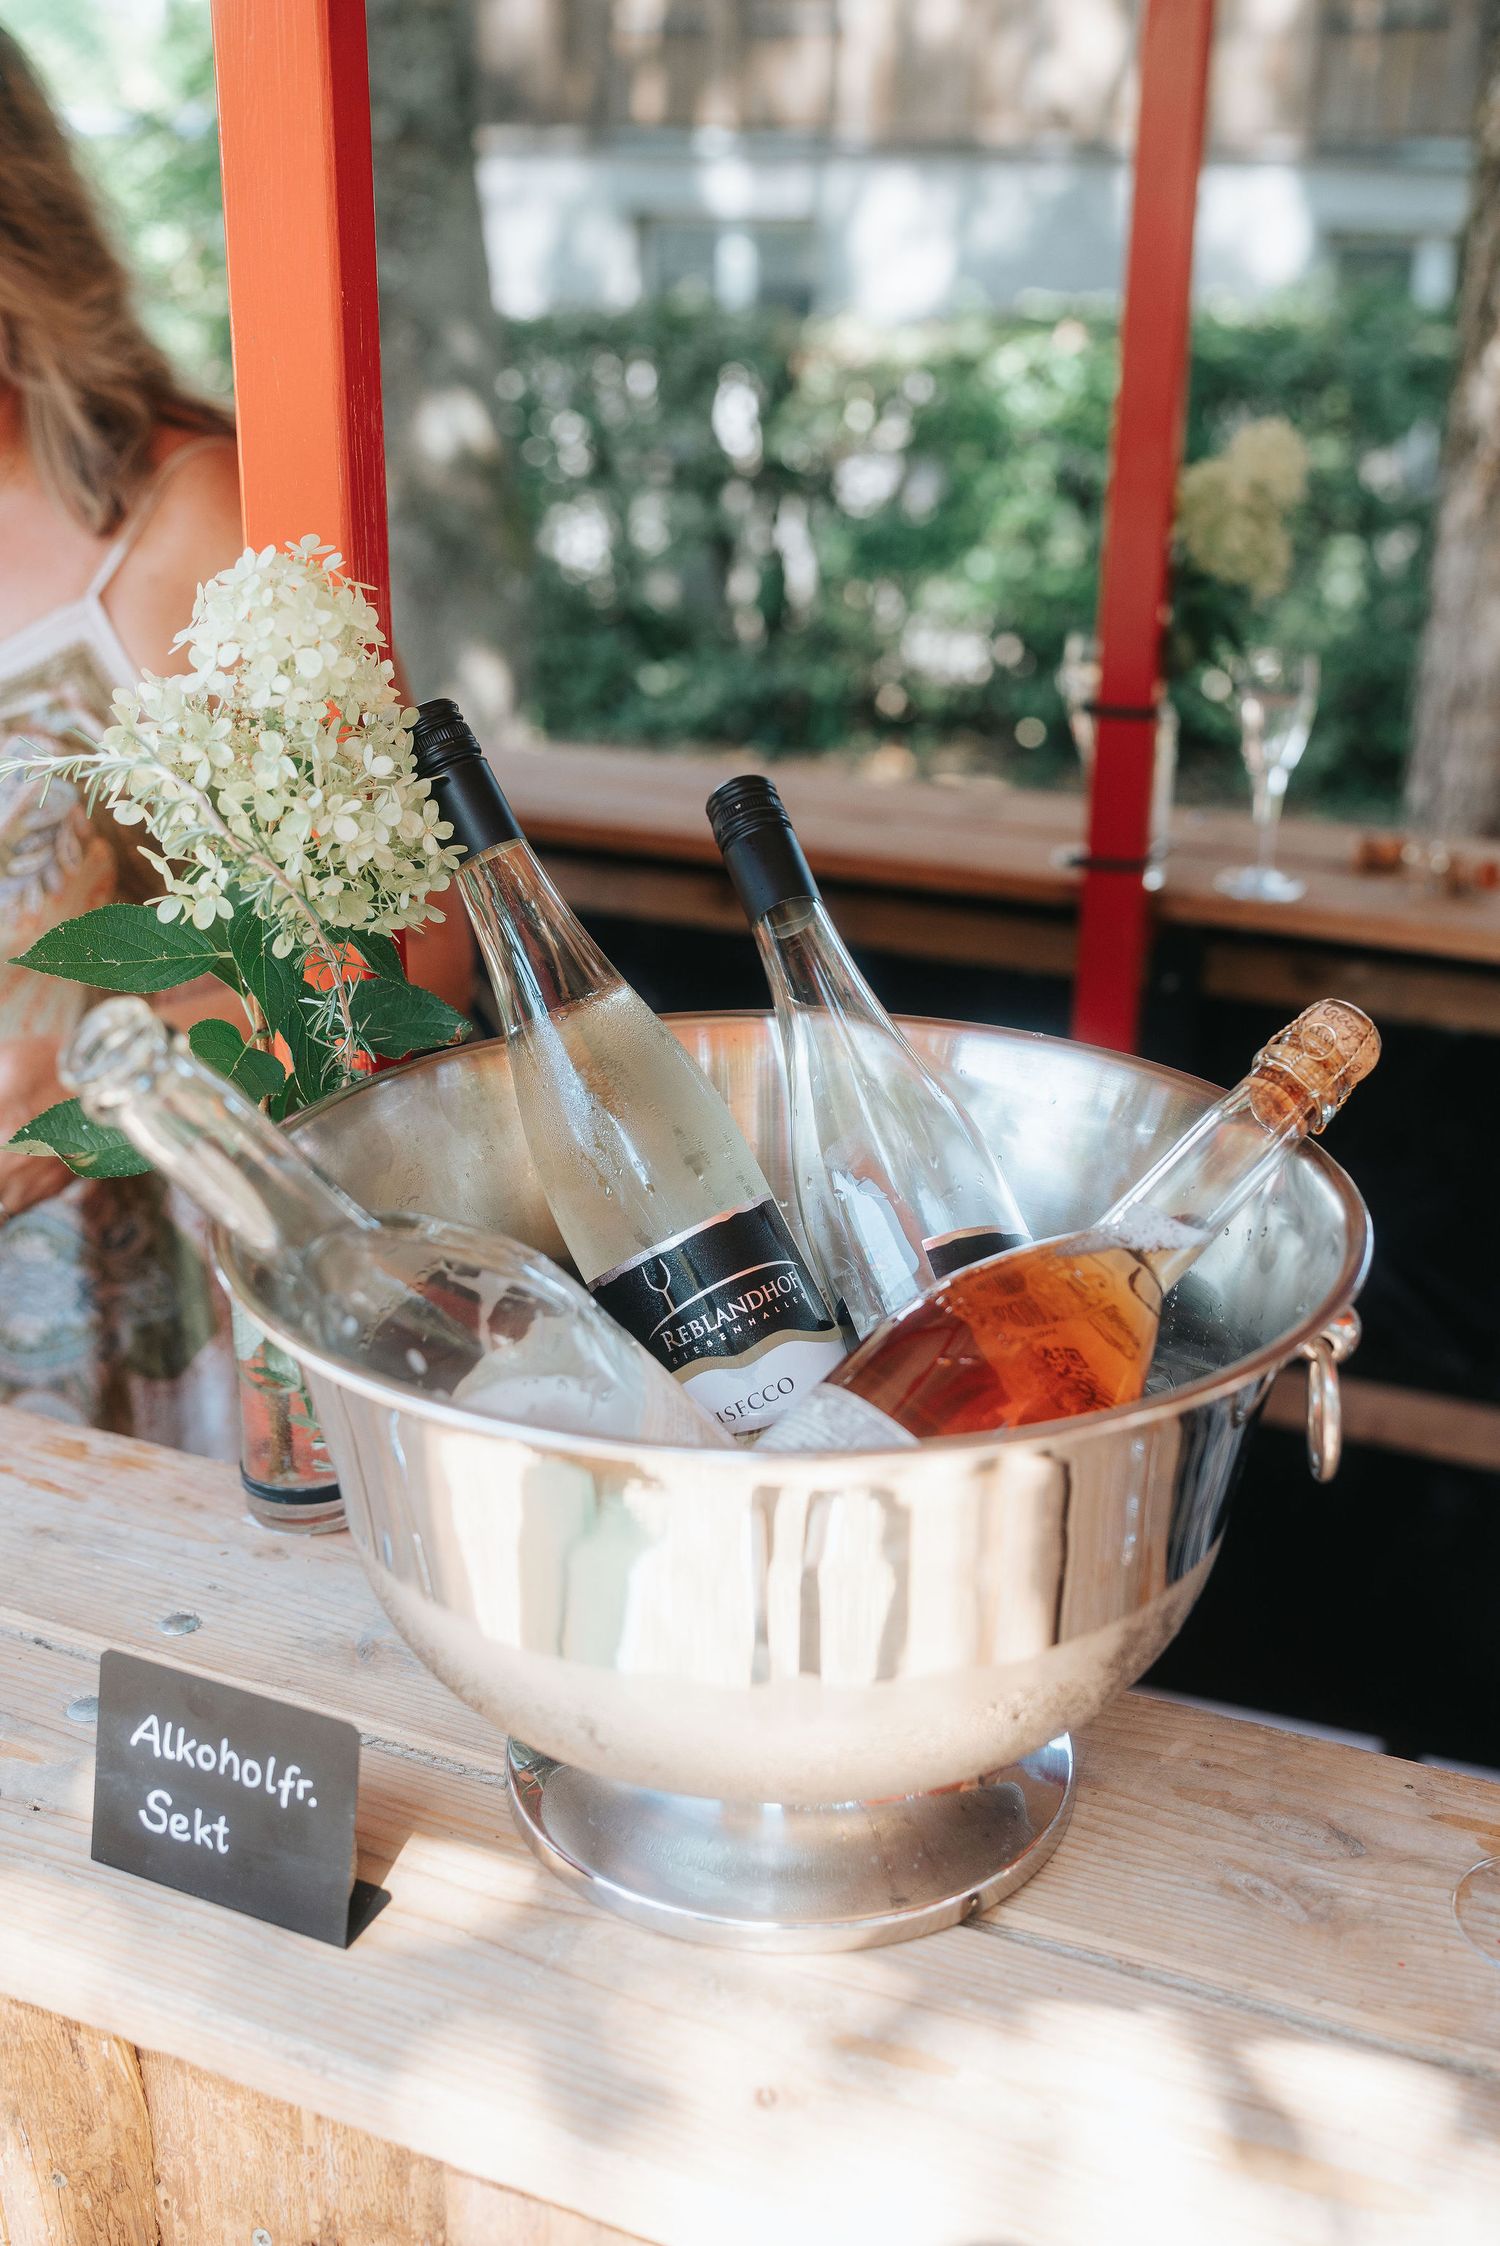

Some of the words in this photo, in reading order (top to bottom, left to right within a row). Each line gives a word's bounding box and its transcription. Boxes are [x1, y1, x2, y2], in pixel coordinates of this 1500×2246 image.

[660, 1271, 799, 1352] REBLANDHOF
[129, 1713, 318, 1809] Alkoholfr.
[137, 1788, 230, 1854] Sekt
